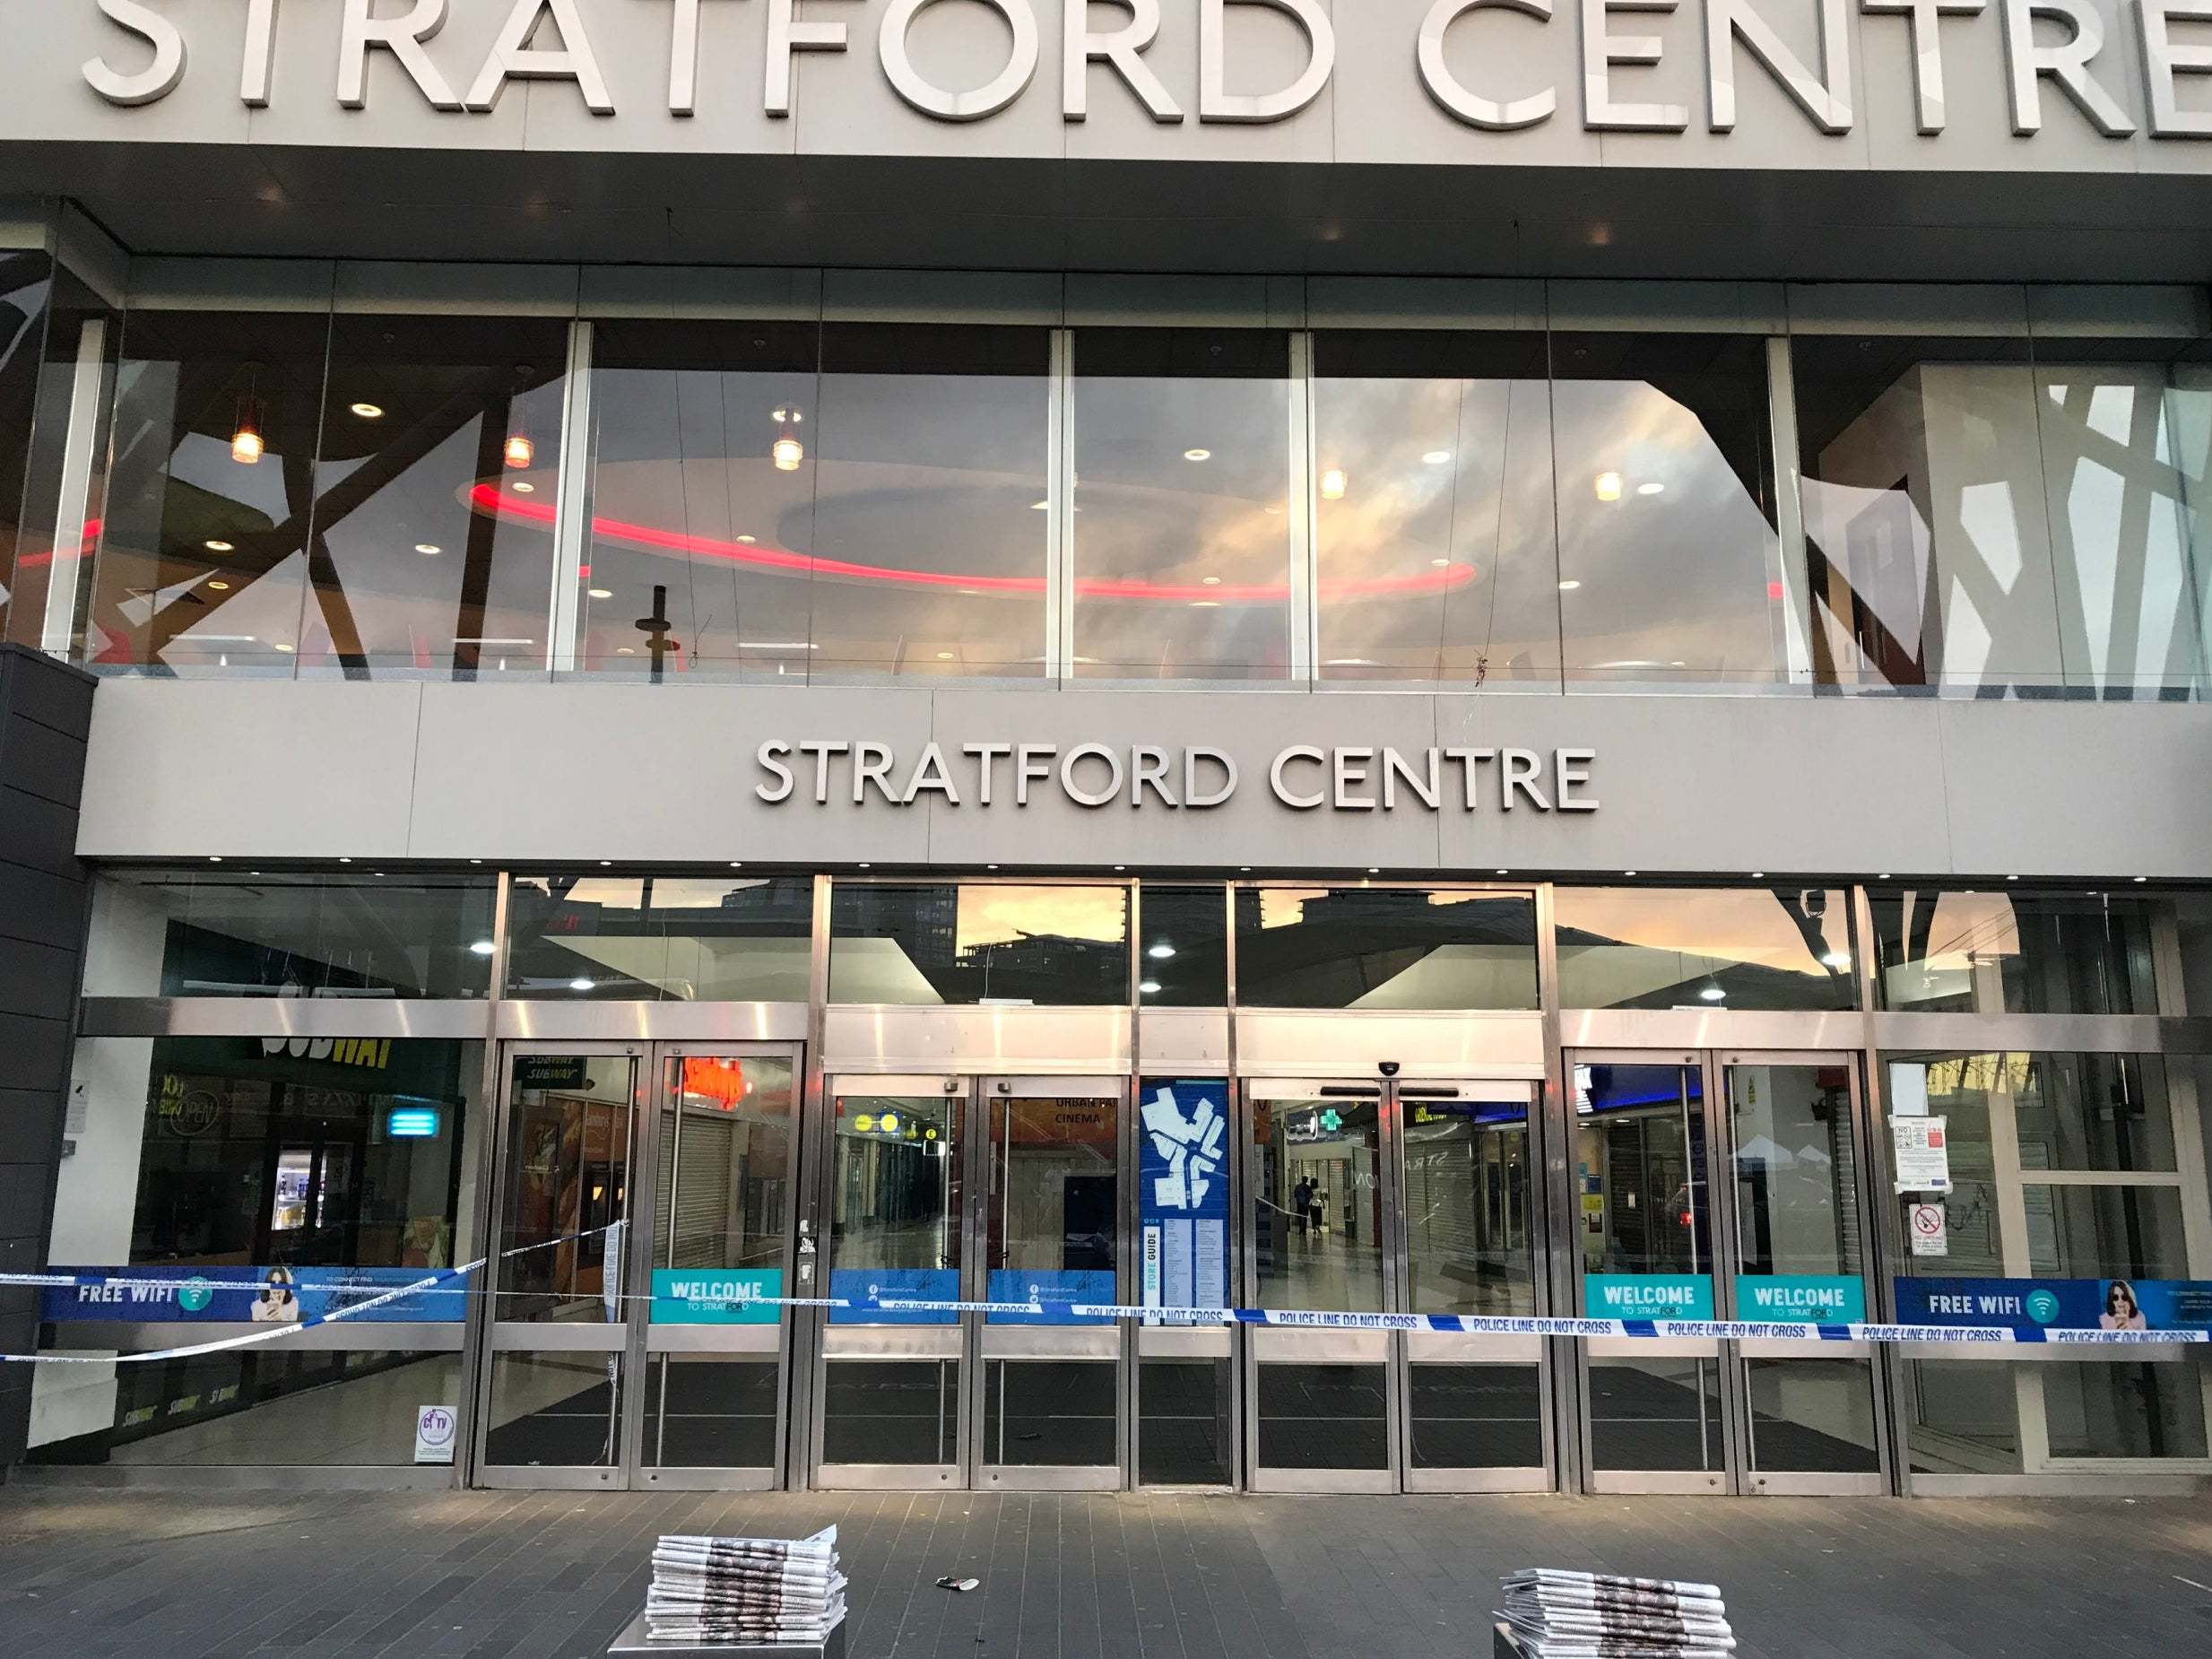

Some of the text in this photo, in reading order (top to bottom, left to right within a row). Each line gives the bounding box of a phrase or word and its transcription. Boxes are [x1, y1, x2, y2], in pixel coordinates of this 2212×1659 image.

[755, 739, 1600, 812] STRATFORD CENTRE
[526, 1068, 578, 1080] SUBWAY
[1054, 1113, 1101, 1124] CINEMA
[1147, 1233, 1156, 1290] STORE GUIDE
[79, 1284, 173, 1303] FREE WIFI
[671, 1281, 763, 1299] WELCOME
[1603, 1286, 1695, 1305] WELCOME
[1753, 1288, 1845, 1307] WELCOME
[688, 1302, 699, 1312] TO
[1621, 1306, 1683, 1316] TO STRATFORD
[1929, 1295, 2021, 1315] FREE WIFI
[1279, 1313, 1418, 1328] POLICE LINE DO NOT CROSS
[1772, 1308, 1834, 1318] TO STRATFORD
[1473, 1318, 1611, 1334] POLICE LINE DO NOT CROSS
[1668, 1323, 1806, 1338] POLICE LINE DO NOT CROSS
[1862, 1327, 2002, 1342] POLICE LINE DO NOT CROSS
[2058, 1332, 2198, 1342] POLICE LINE DO NOT CROSS
